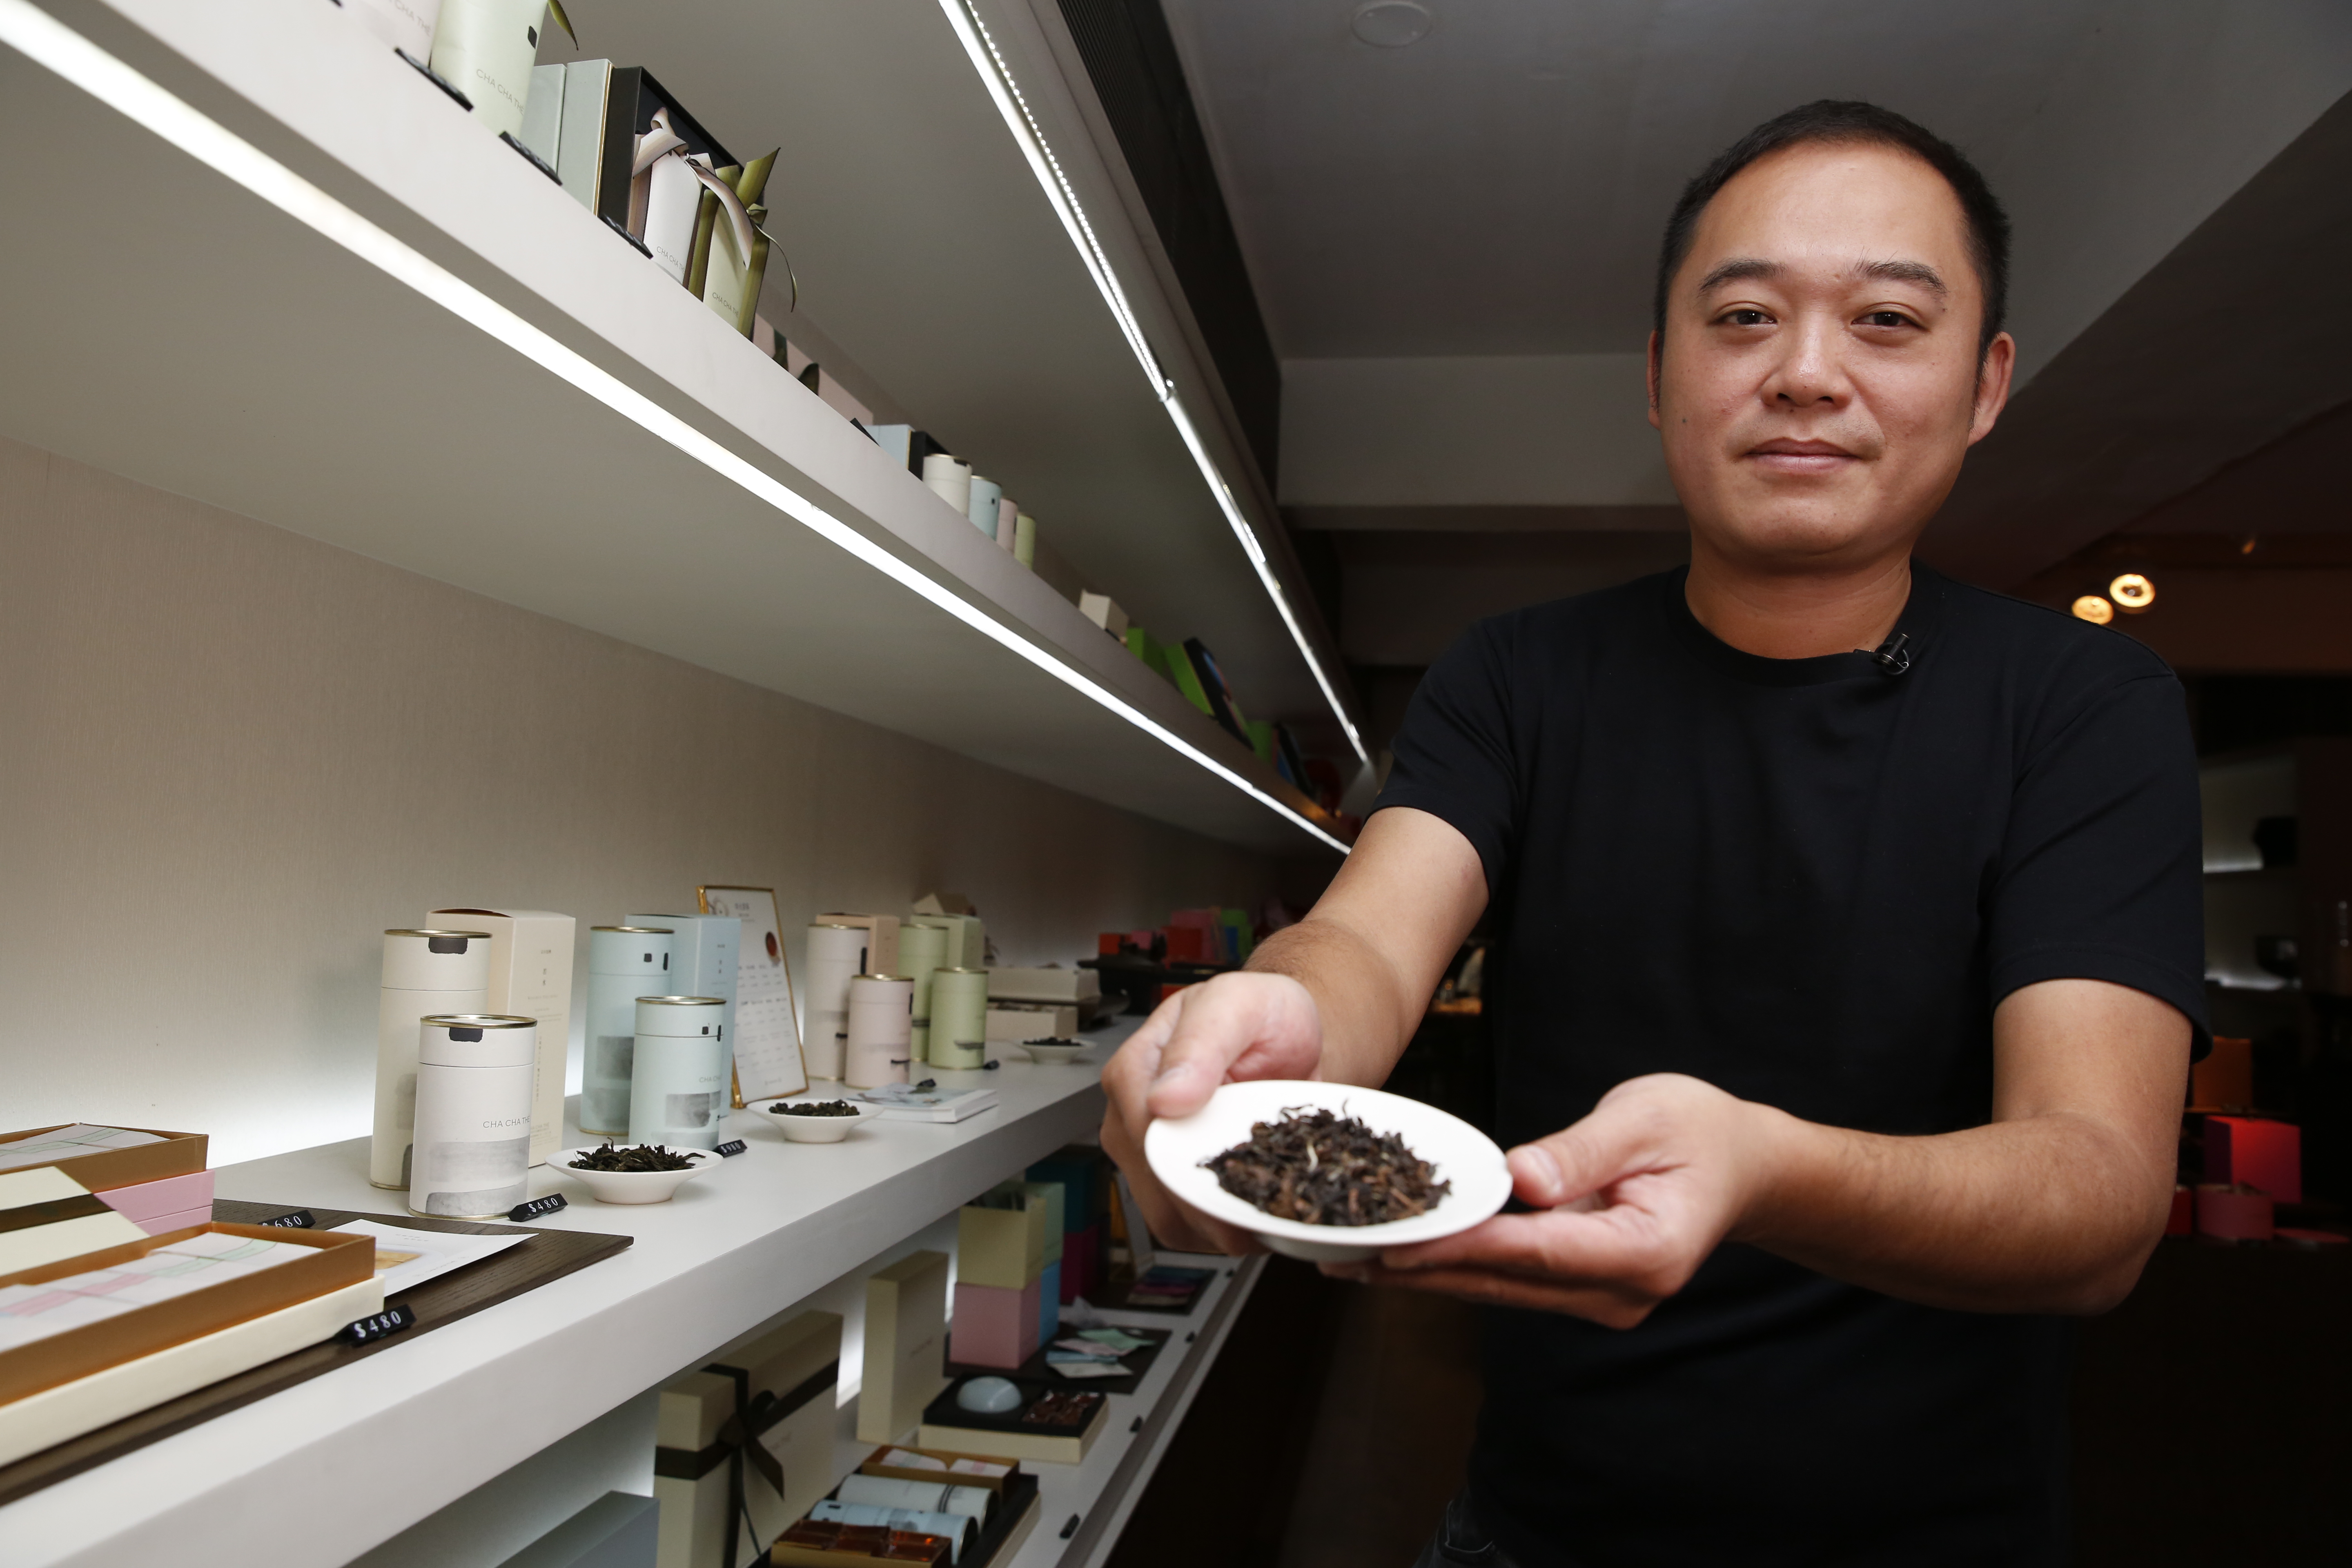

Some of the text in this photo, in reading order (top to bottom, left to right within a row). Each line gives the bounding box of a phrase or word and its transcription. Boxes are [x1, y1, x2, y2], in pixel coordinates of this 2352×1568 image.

[477, 69, 495, 88] CHA
[498, 84, 512, 103] CHA
[657, 246, 668, 259] CHA
[669, 255, 678, 267] CHA
[713, 292, 723, 304] CHA
[723, 300, 732, 311] CHA
[505, 1118, 521, 1127] CHA
[528, 1197, 559, 1213] $480
[354, 1311, 401, 1338] $480
